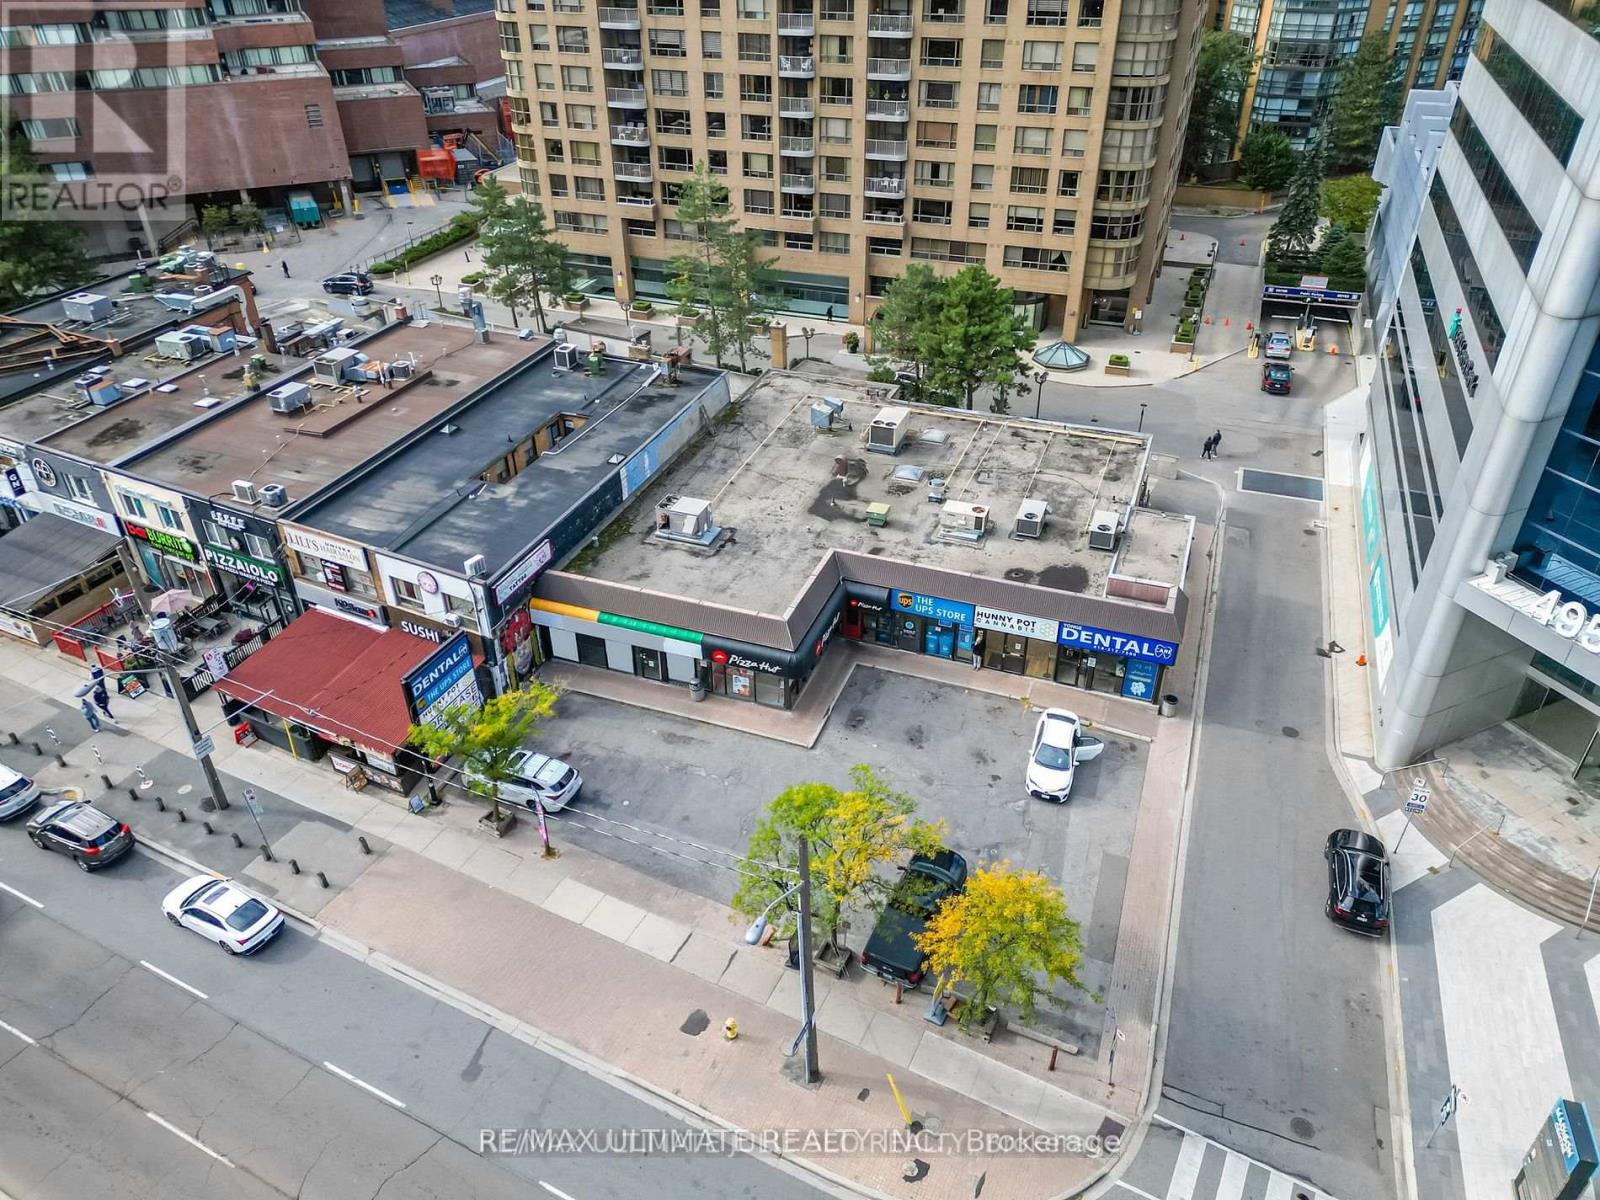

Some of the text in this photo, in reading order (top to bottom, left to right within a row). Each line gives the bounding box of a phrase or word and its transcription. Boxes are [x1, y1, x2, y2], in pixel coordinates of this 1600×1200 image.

[204, 548, 279, 583] PIZZAIOLO
[916, 595, 935, 606] THE
[915, 603, 967, 622] UPS STORE
[976, 611, 1037, 628] HUNNY POT
[401, 620, 440, 643] SUSHI
[976, 618, 1035, 633] CANNABIS
[1061, 628, 1155, 657] DENTAL
[728, 654, 782, 673] Pizza Hut
[412, 652, 461, 697] DENTAL
[427, 689, 439, 701] THE
[440, 678, 452, 691] UPS
[1411, 793, 1427, 803] 30
